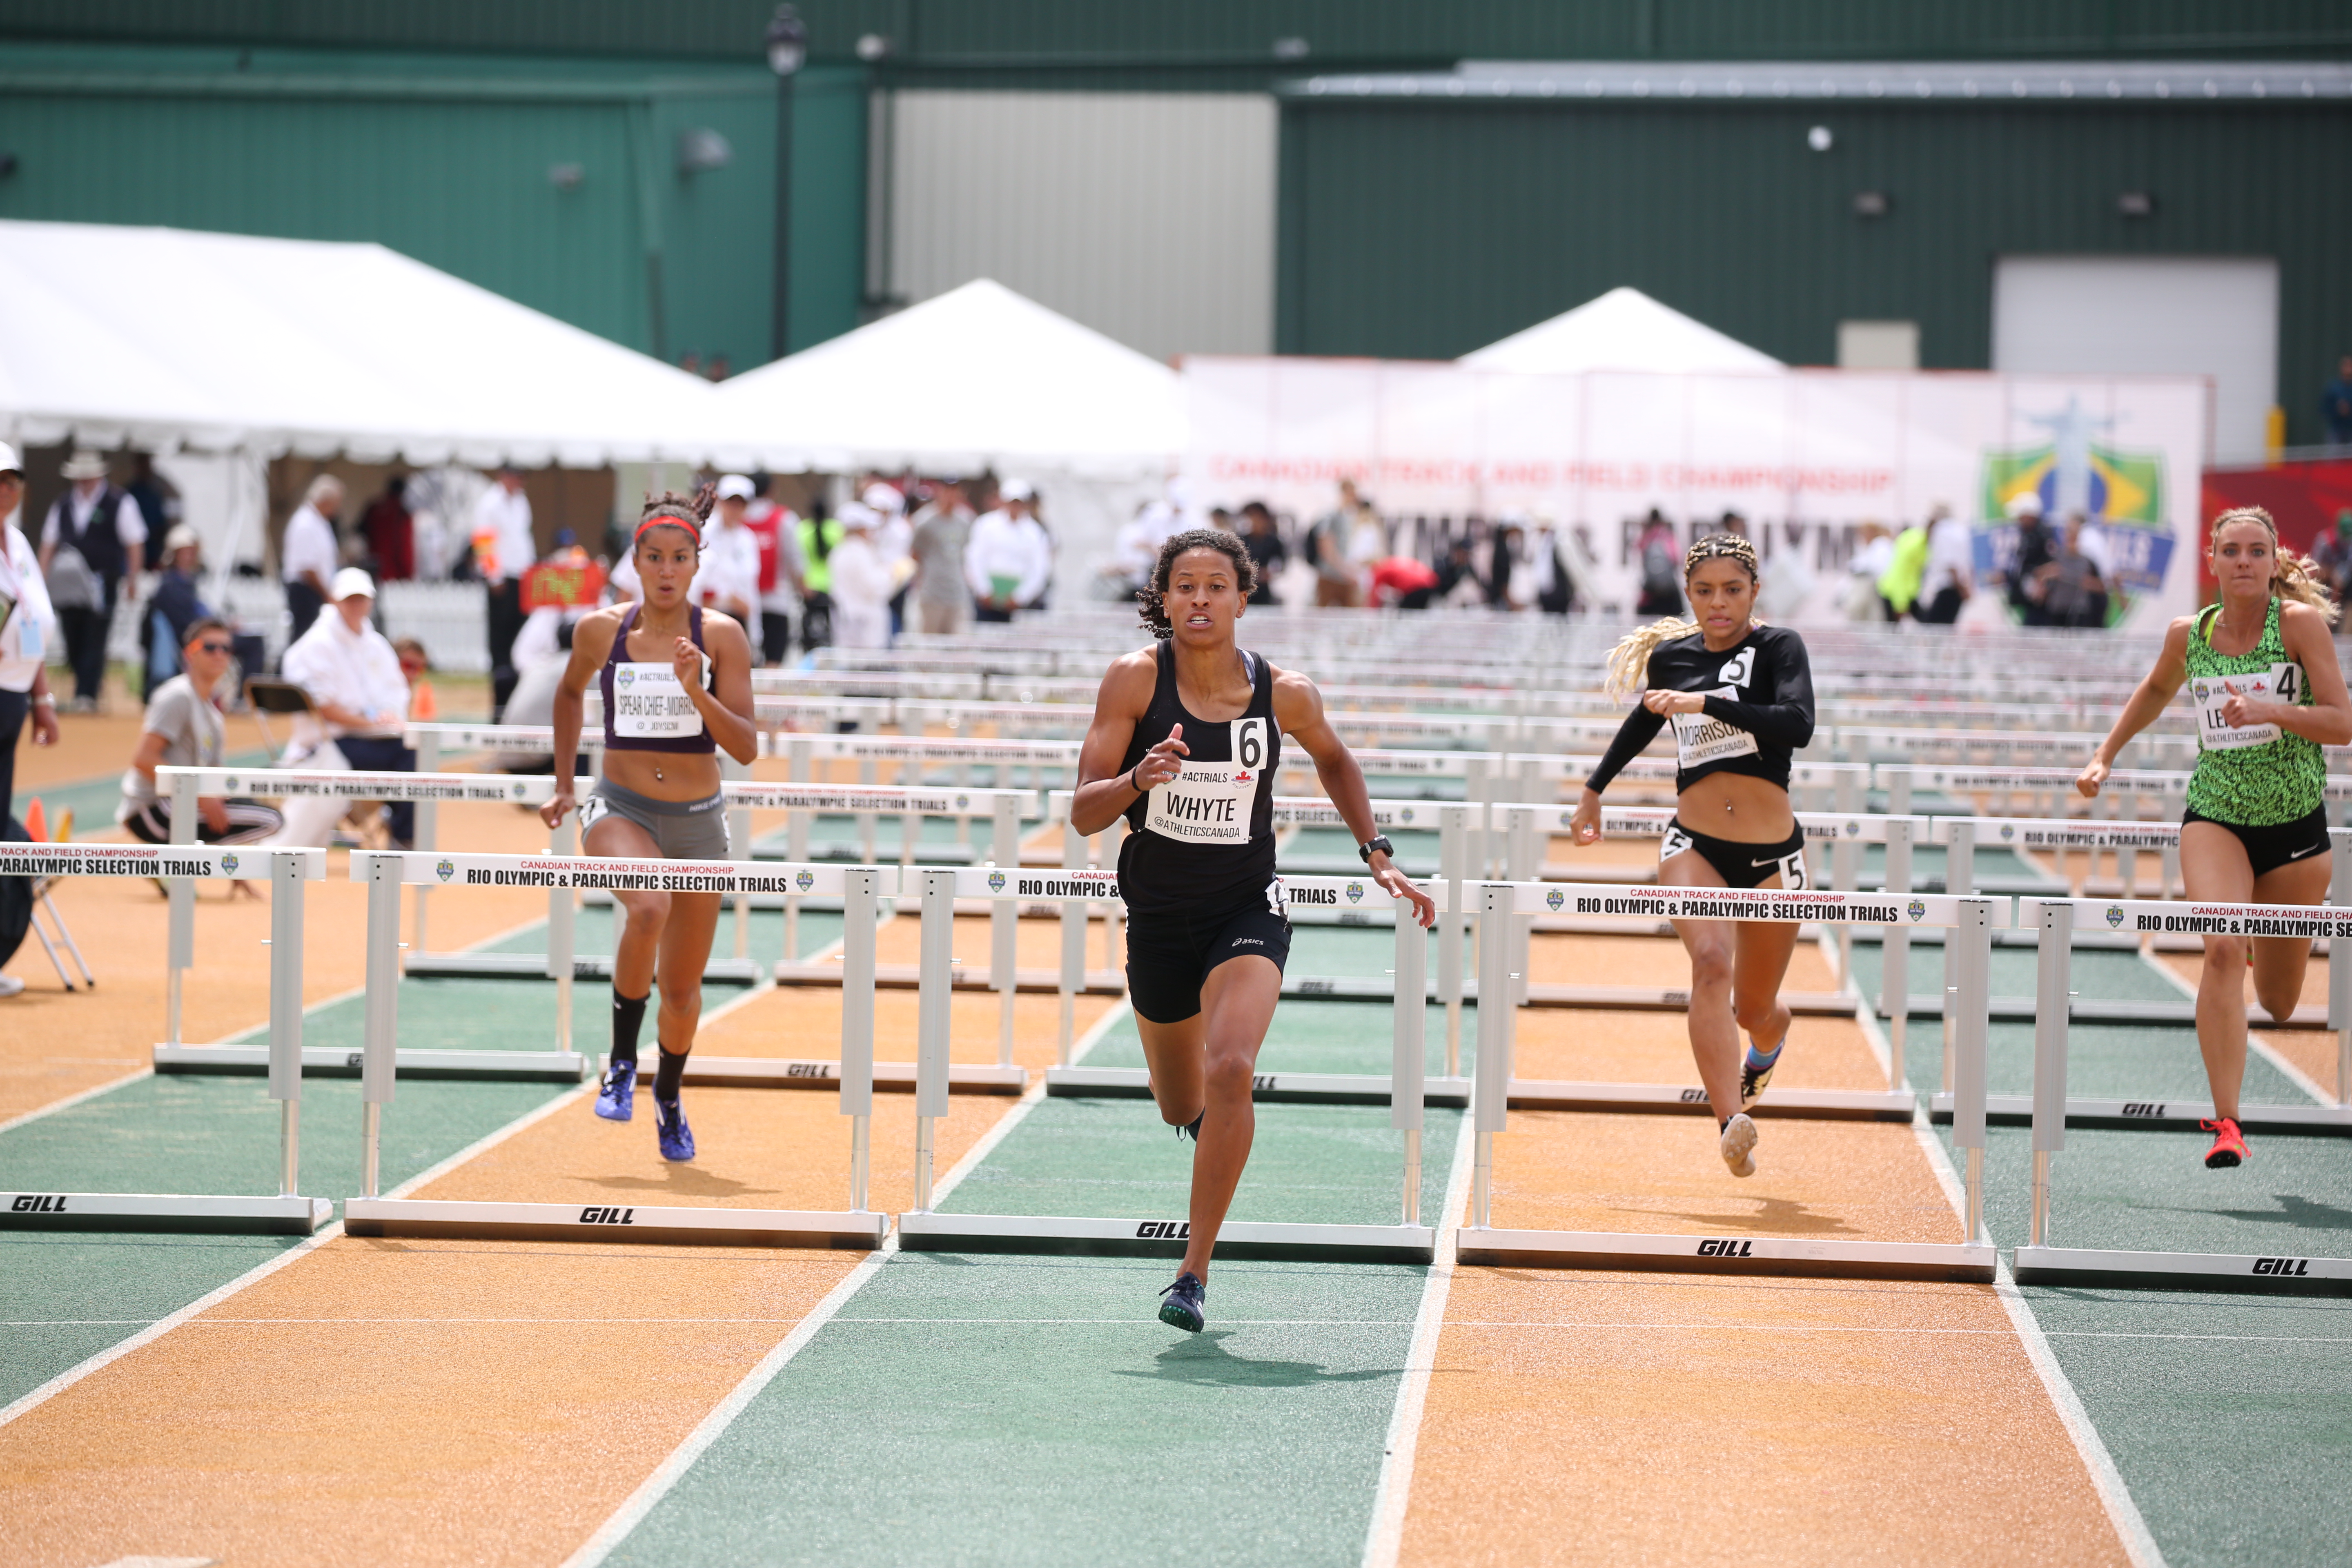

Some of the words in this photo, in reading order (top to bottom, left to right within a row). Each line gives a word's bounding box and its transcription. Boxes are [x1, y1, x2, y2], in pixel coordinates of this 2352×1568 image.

[1491, 460, 1551, 486] AND
[2276, 666, 2296, 702] 4
[619, 695, 641, 715] SPEAR
[1239, 721, 1261, 768] 6
[2206, 729, 2273, 744] @ATHLETICSCANADA
[1182, 772, 1227, 783] #ACTRIALS
[1167, 791, 1237, 822] WHYTE
[1154, 816, 1240, 837] @ATHLETICSCANADA
[2025, 832, 2044, 842] RIO
[2047, 833, 2095, 844] OLYMPIC
[2109, 835, 2179, 846] PARALYMPIC
[31, 848, 52, 856] AND
[55, 849, 82, 857] FIELD
[85, 849, 158, 858] CHAMPIONSHIP
[86, 859, 159, 875] SELECTION
[164, 861, 211, 875] TRIALS
[521, 860, 570, 870] CANADIAN
[574, 862, 606, 871] TRACK
[608, 864, 628, 872] AND
[632, 864, 659, 873] FIELD
[661, 865, 734, 874] CHAMPIONSHIP
[1788, 855, 1804, 890] 5
[467, 869, 490, 884] RIO
[495, 870, 555, 886] OLYMPIC
[559, 875, 568, 887] &
[572, 873, 659, 890] PARALYMPIC
[662, 875, 735, 891] SELECTION
[739, 877, 786, 892] TRIALS
[1019, 880, 1042, 895] RIO
[1046, 880, 1106, 897] OLYMPIC
[1109, 885, 1119, 897] &
[1289, 888, 1336, 904] TRIALS
[1630, 889, 1681, 898] CANADIAN
[1683, 890, 1717, 899] TRACK
[1718, 891, 1739, 900] AND
[1742, 892, 1769, 901] FIELD
[1771, 893, 1845, 903] CHAMPIONSHIP
[1577, 897, 1601, 913] RIO
[1605, 898, 1665, 915] OLYMPIC
[1668, 903, 1679, 915] &
[1682, 900, 1769, 918] PARALYMPIC
[1773, 903, 1846, 920] SELECTION
[1849, 905, 1898, 922] TRIALS
[2191, 906, 2243, 916] CANADIAN
[2245, 908, 2279, 918] TRACK
[2281, 910, 2302, 918] AND
[2305, 910, 2332, 919] FIELD
[2137, 915, 2161, 930] RIO
[2165, 915, 2227, 933] OLYMPIC
[2230, 921, 2241, 933] &
[2244, 919, 2332, 937] PARALYMPIC
[787, 1063, 829, 1078] GILL
[2122, 1103, 2166, 1118] GILL
[11, 1196, 67, 1212] GILL
[579, 1207, 634, 1225] GILL
[1697, 1240, 1753, 1257] GILL
[2252, 1258, 2309, 1276] GILL
